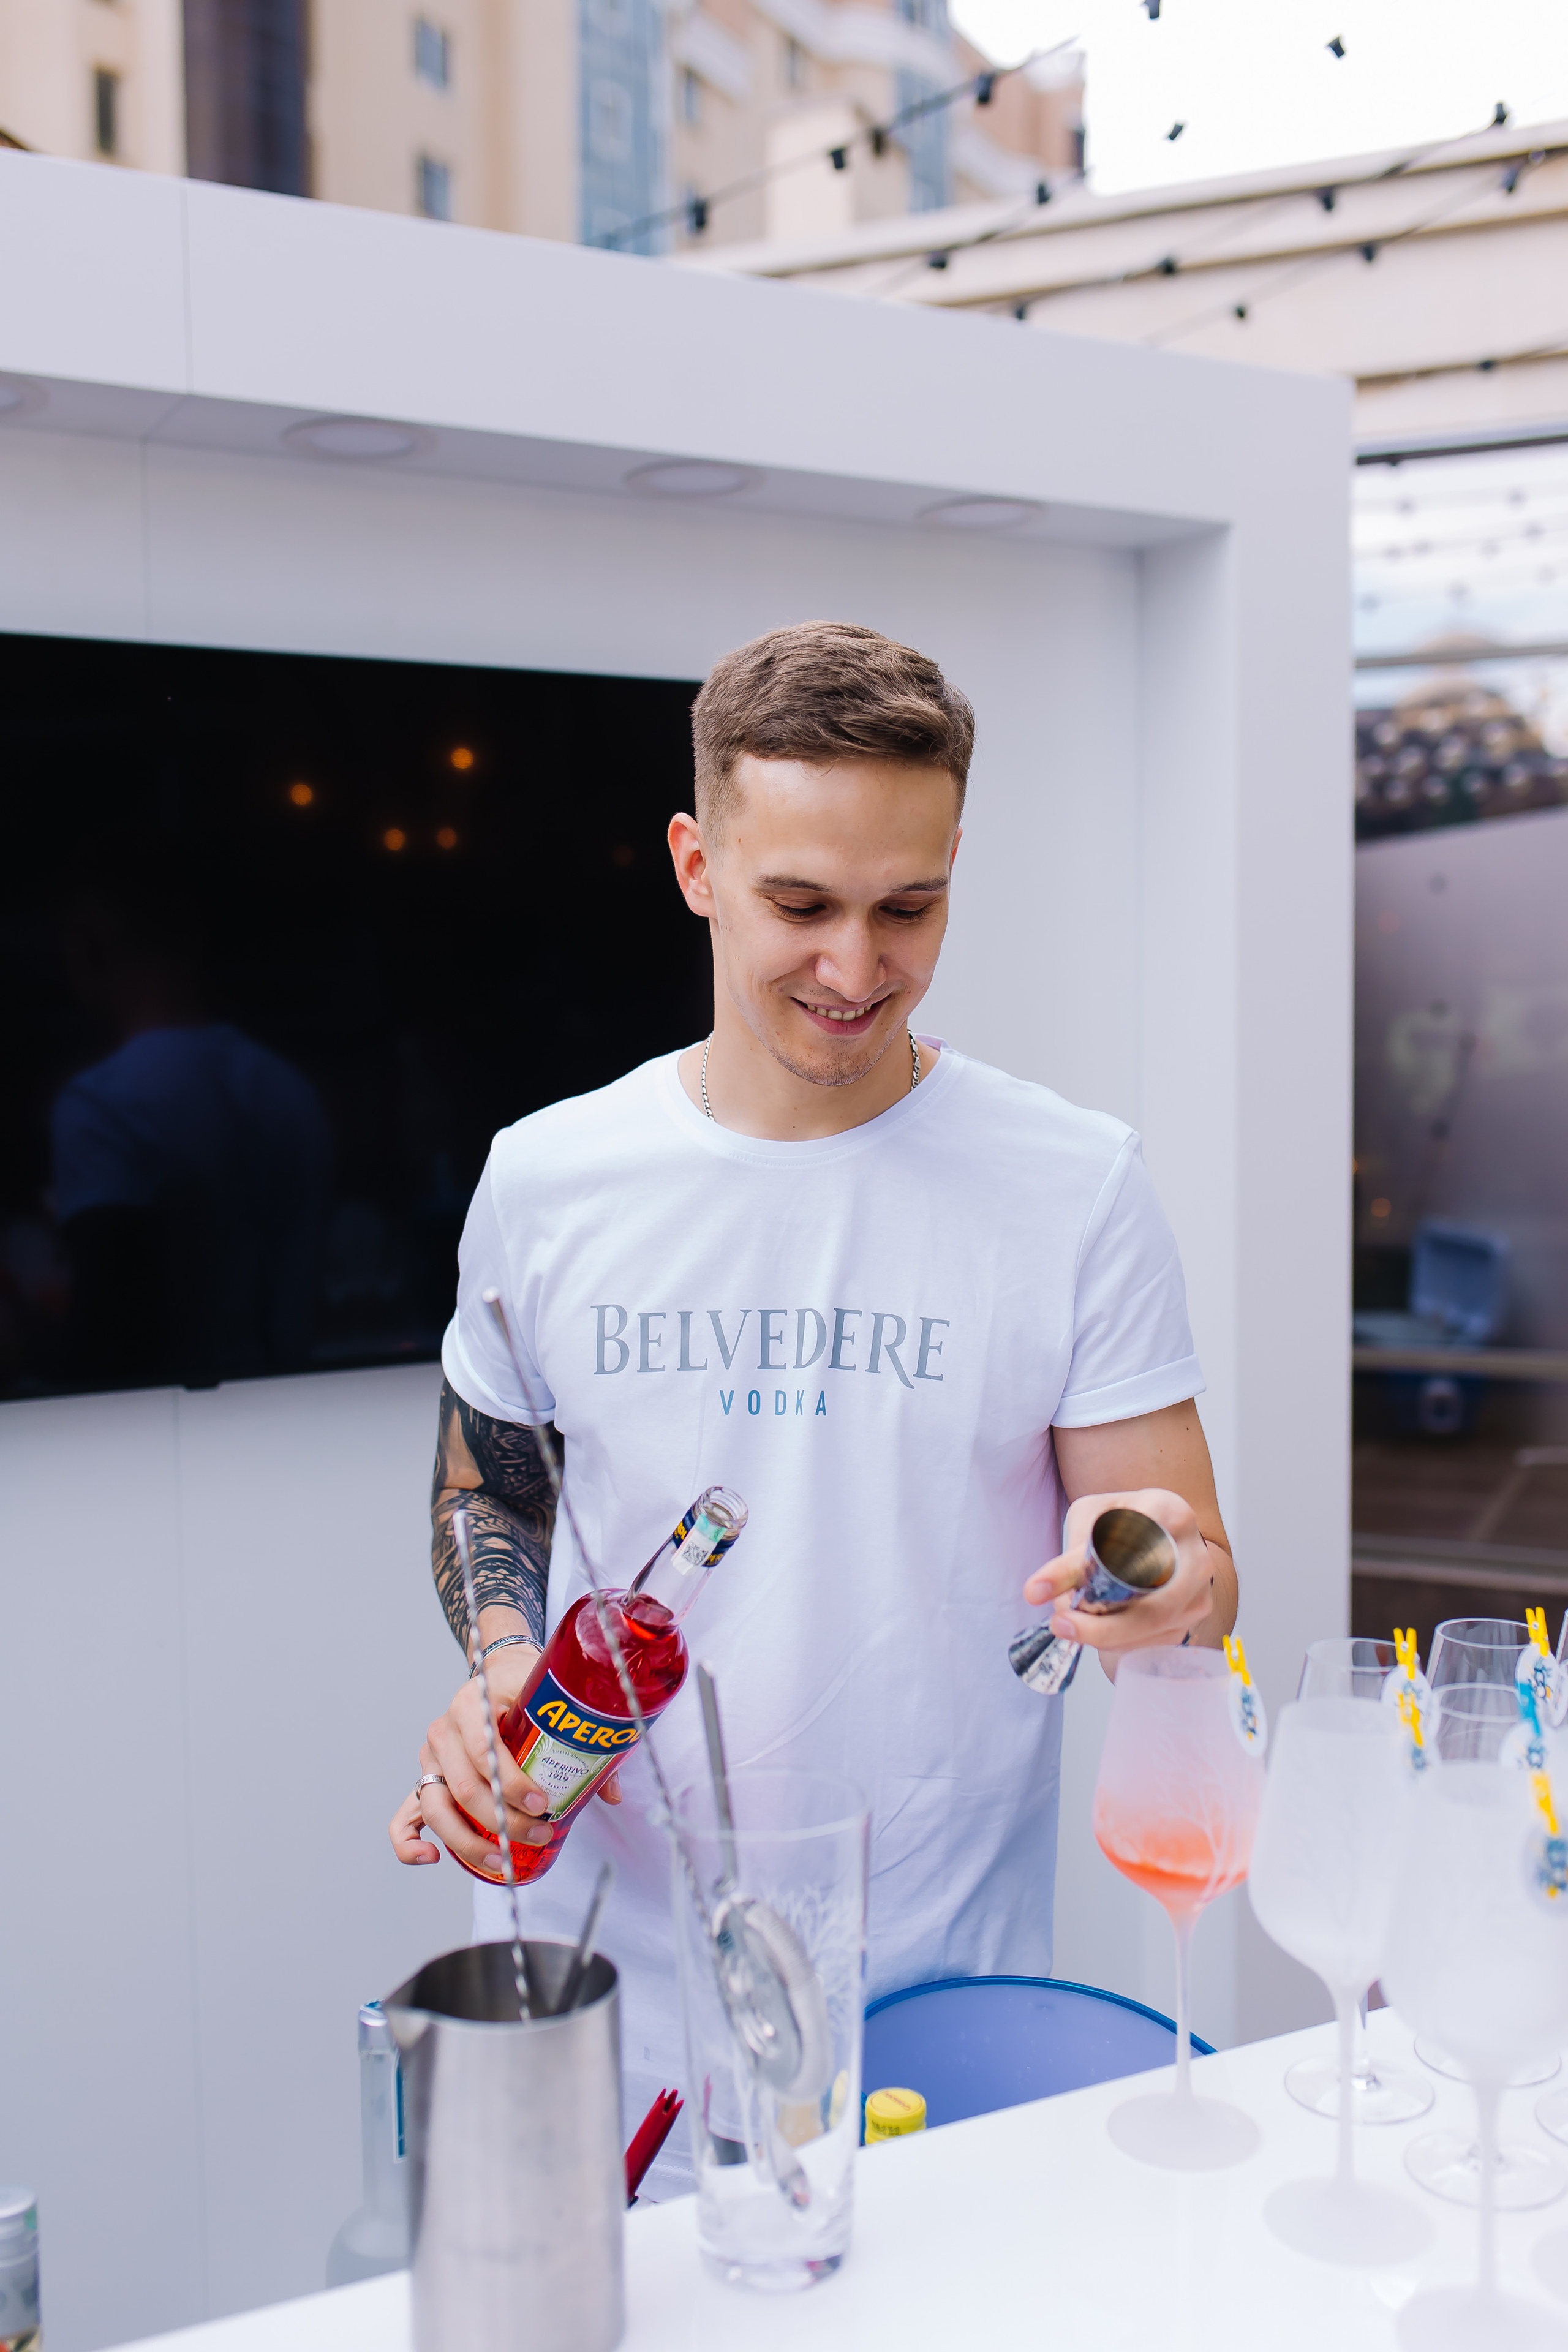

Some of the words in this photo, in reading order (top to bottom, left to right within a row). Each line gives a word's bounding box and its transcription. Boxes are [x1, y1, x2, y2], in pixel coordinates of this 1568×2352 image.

[590, 1304, 950, 1389] BELVEDERE
[720, 1390, 826, 1416] VODKA
[541, 1757, 589, 1775] APERITIVO
[548, 1772, 569, 1782] 1919
